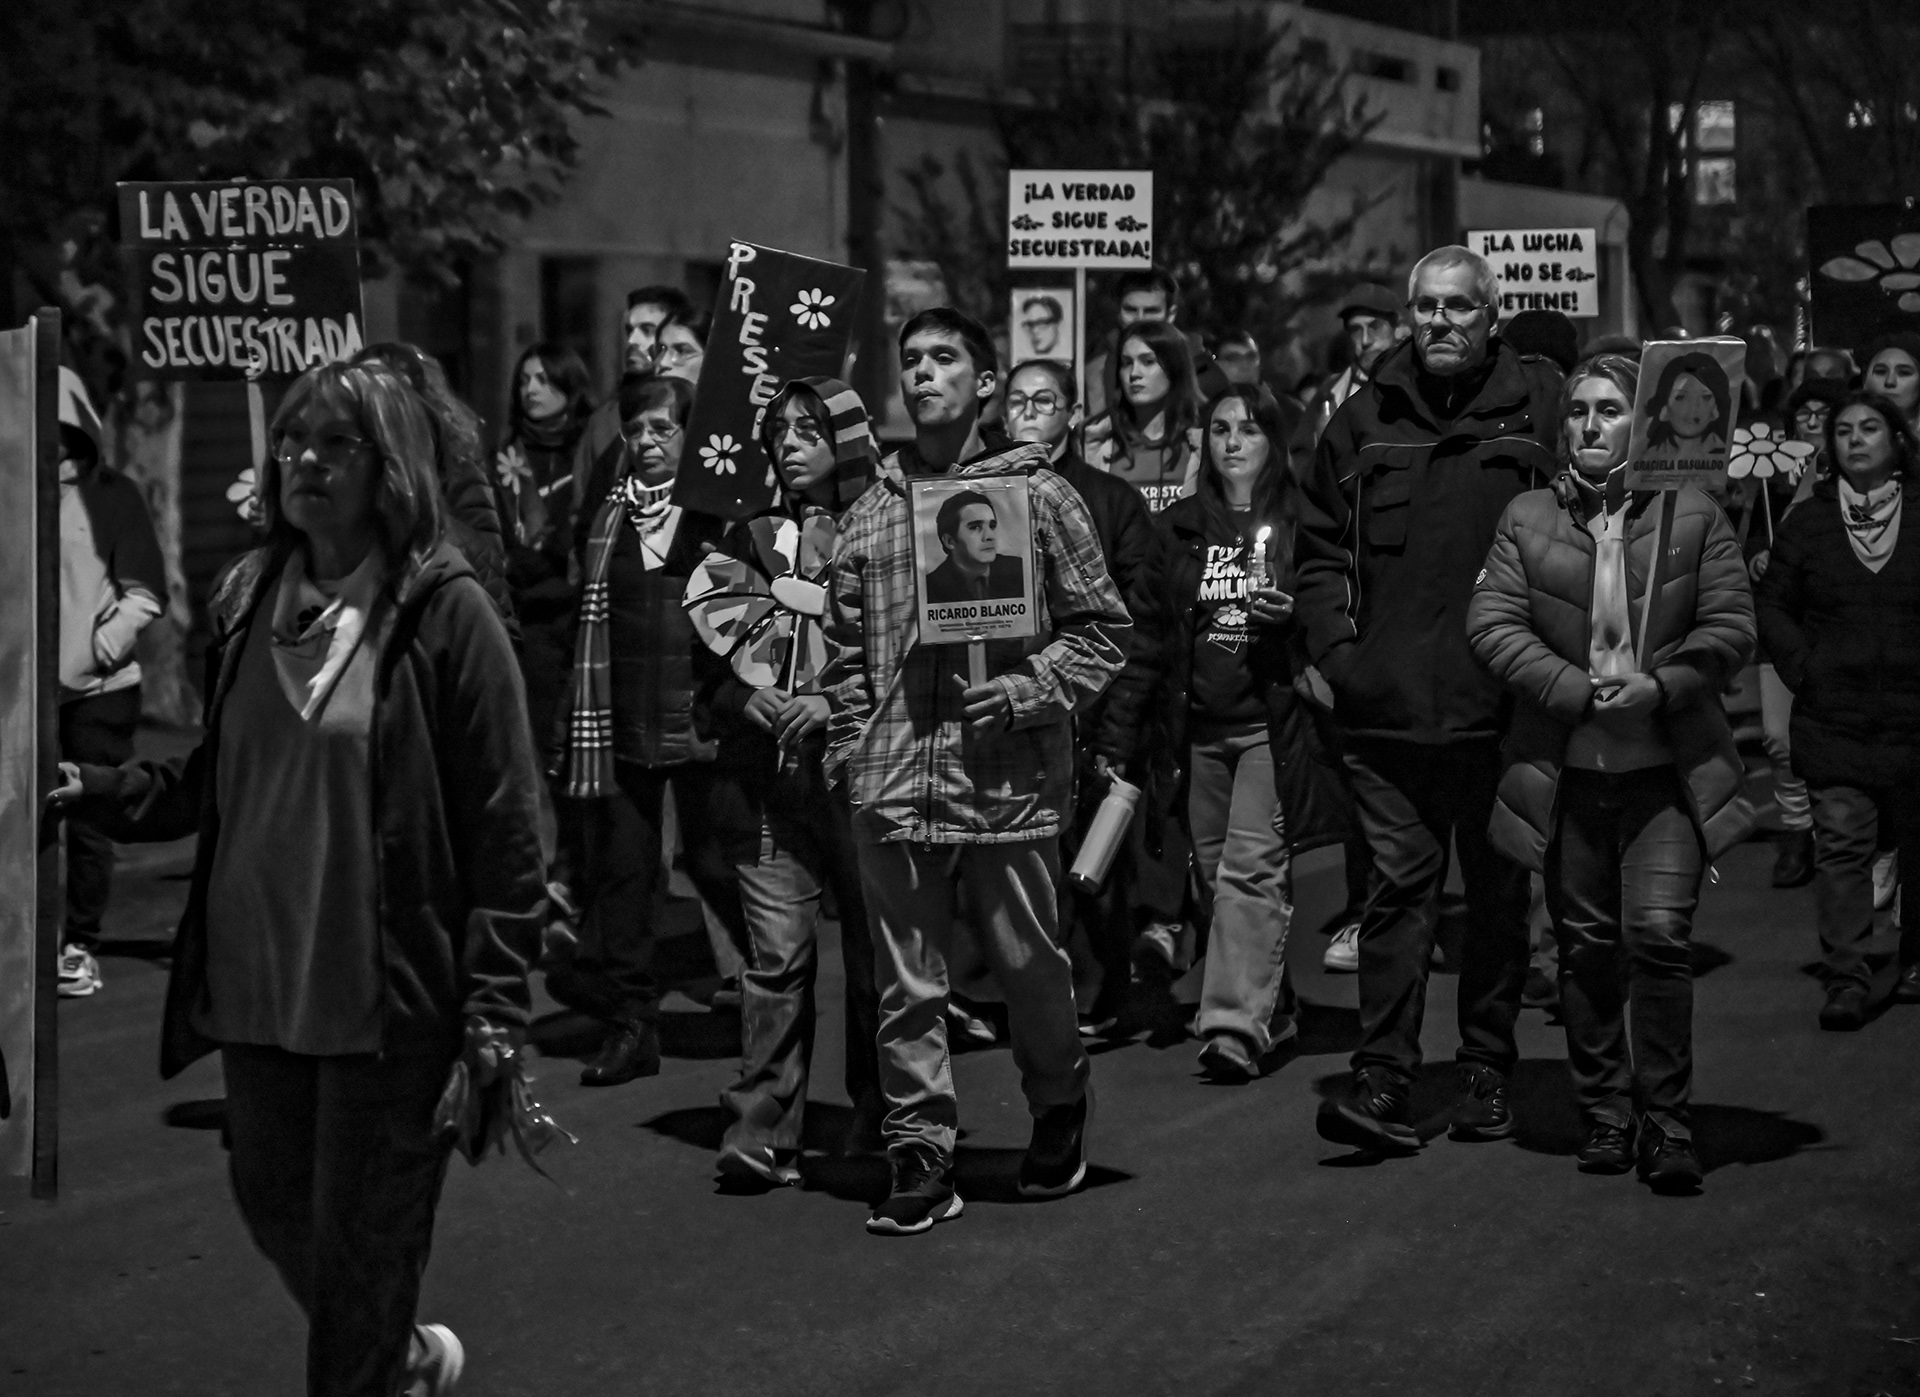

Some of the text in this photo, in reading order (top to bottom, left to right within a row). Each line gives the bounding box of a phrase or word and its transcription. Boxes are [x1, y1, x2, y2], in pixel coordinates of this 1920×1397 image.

[1025, 182, 1136, 204] ¡LA VERDAD
[138, 185, 350, 241] LA VERDAD
[1052, 210, 1107, 229] SIGUE
[1009, 239, 1150, 260] SECUESTRADA!
[1483, 232, 1583, 256] ¡LA LUCHA
[150, 251, 296, 304] SIGUE
[1504, 262, 1562, 282] NO SE
[142, 312, 363, 378] SECUESTRADA
[1633, 459, 1725, 471] GRACIELA BASUALDO
[927, 603, 1026, 621] RICARDO BLANCO
